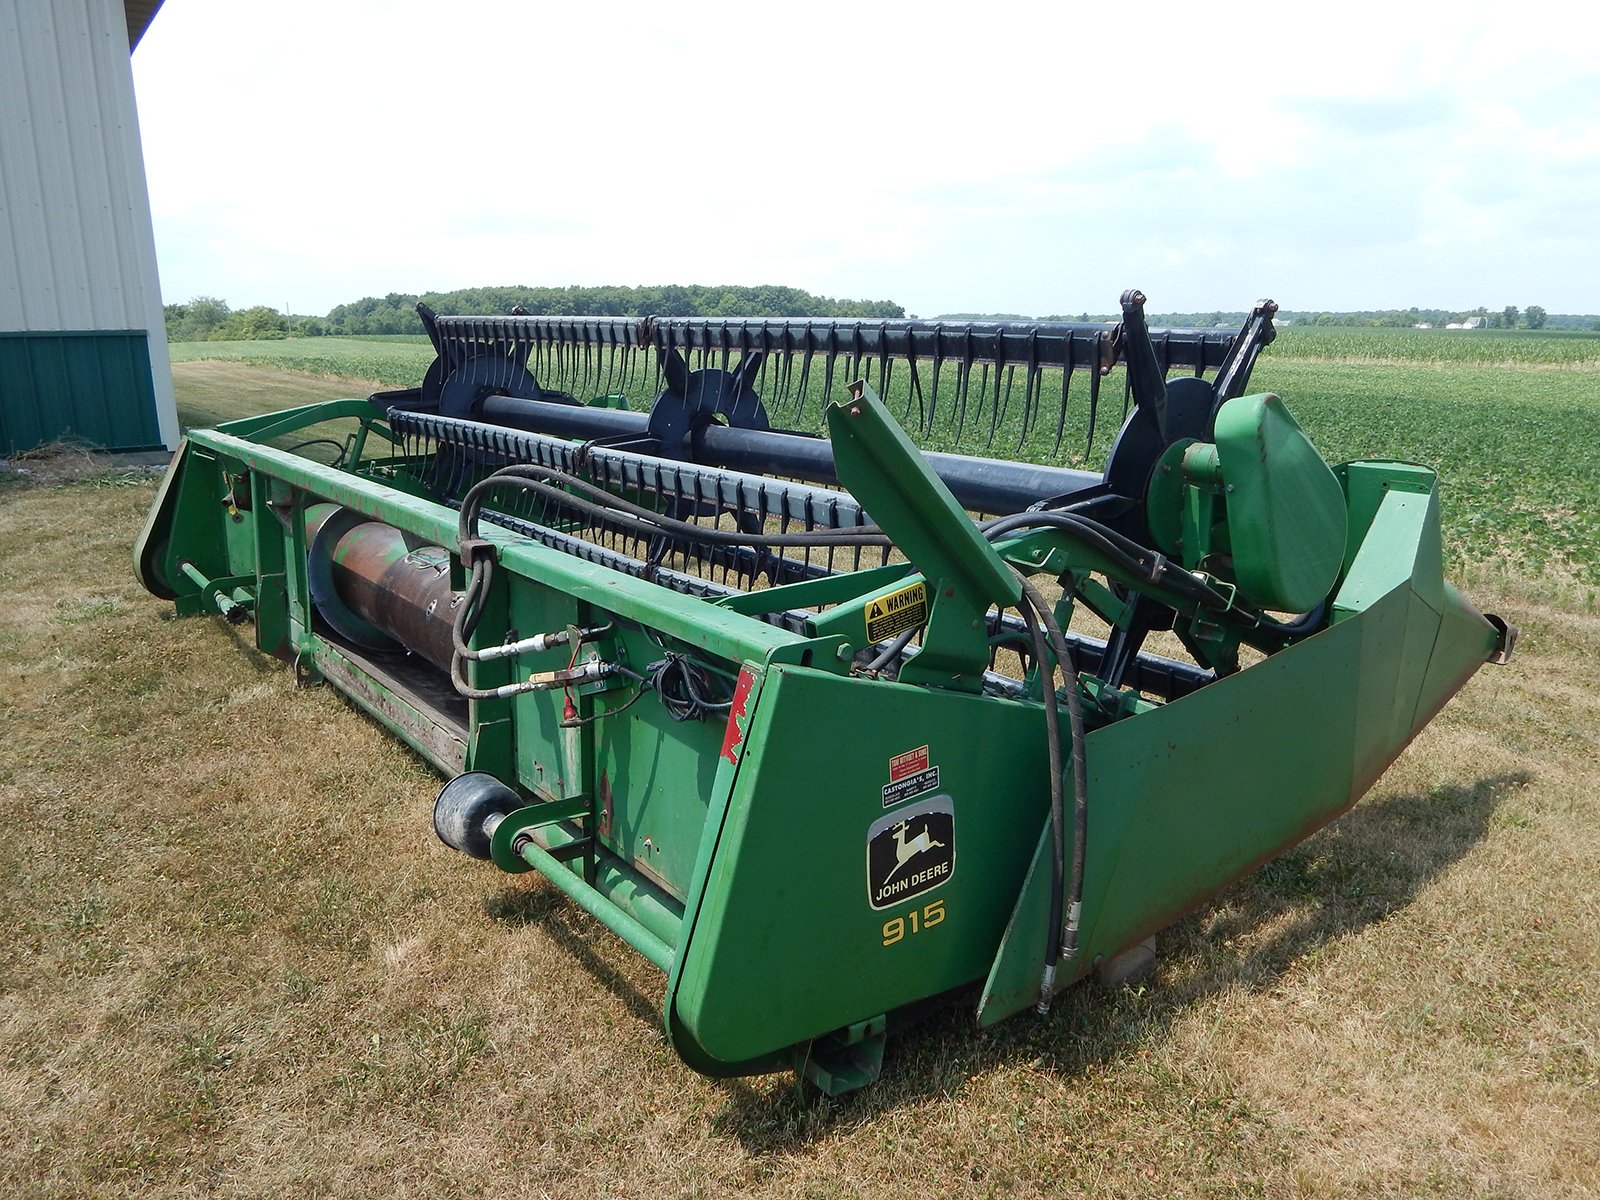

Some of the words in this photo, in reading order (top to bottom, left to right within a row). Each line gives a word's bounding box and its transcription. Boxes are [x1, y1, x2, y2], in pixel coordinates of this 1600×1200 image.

[886, 586, 923, 613] WARNING
[876, 878, 909, 901] JOHN
[911, 861, 949, 887] DEERE
[882, 898, 946, 947] 915
